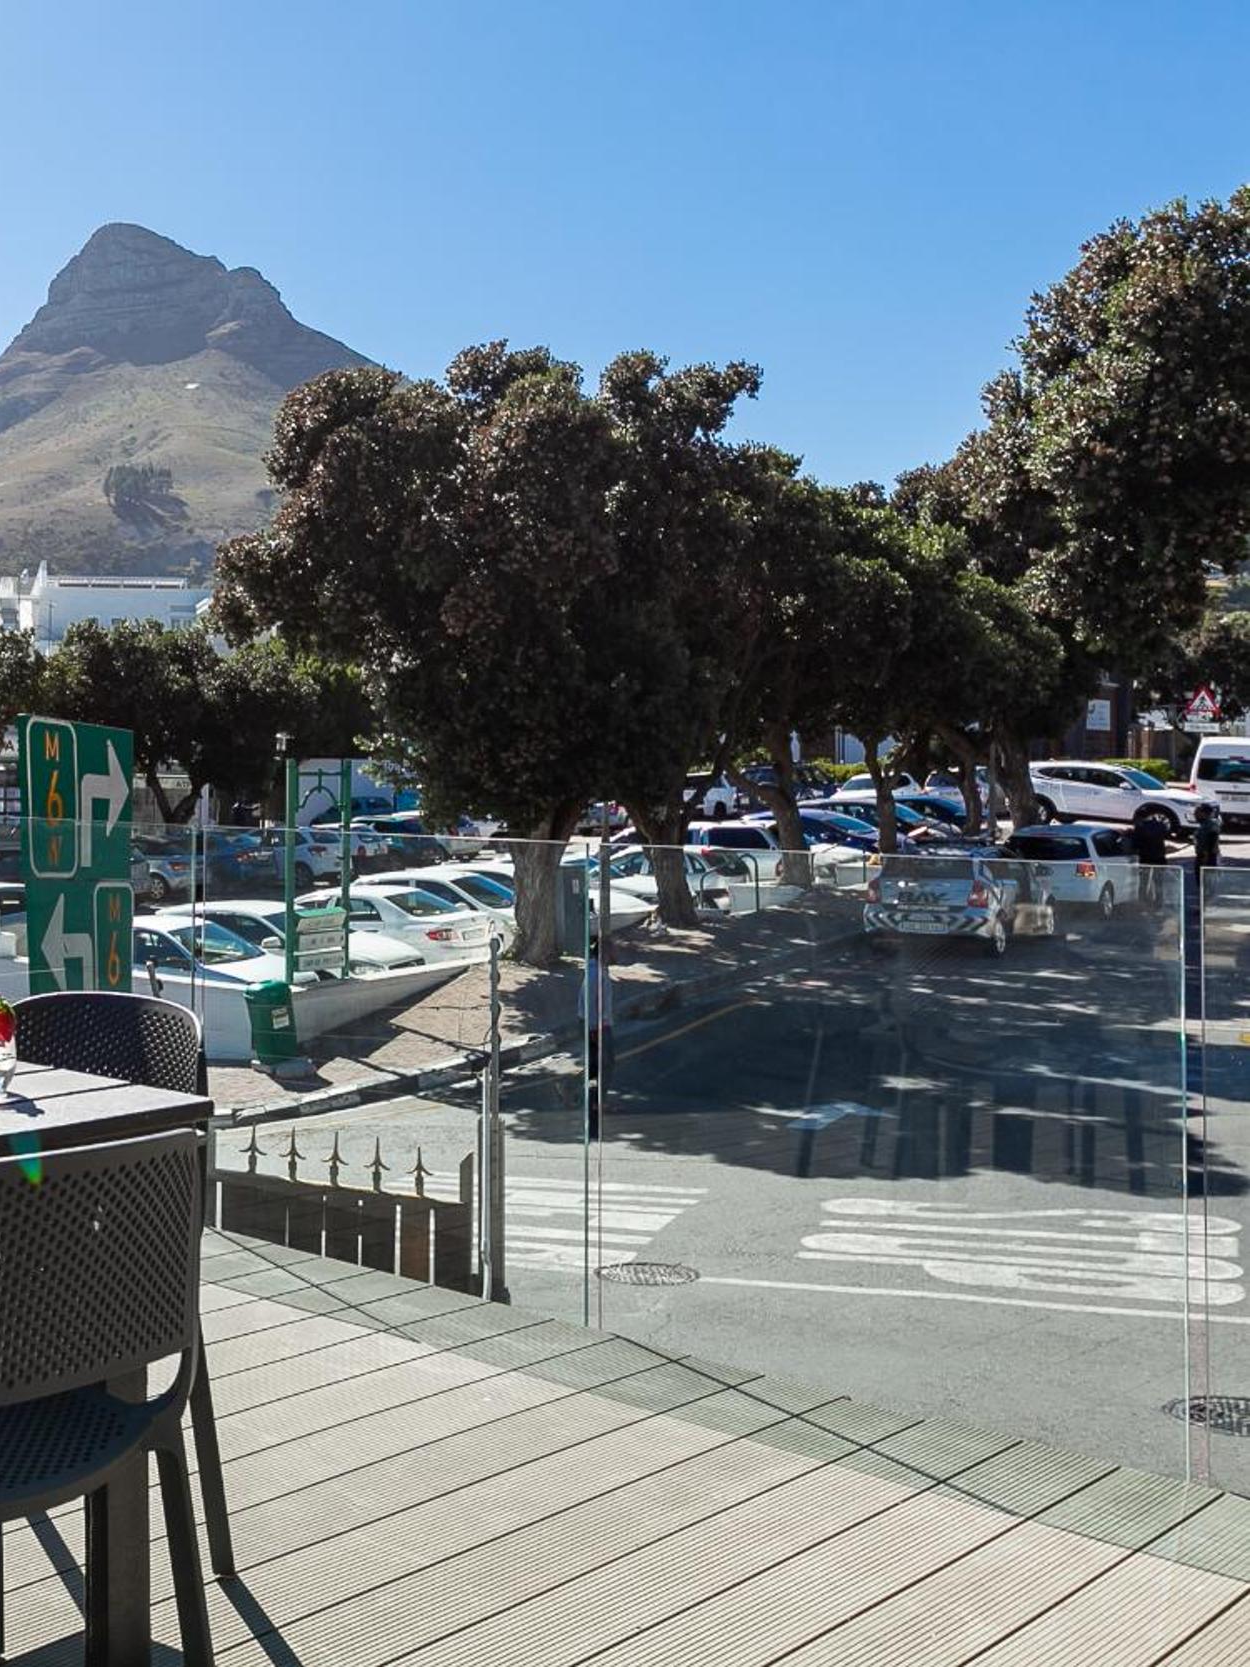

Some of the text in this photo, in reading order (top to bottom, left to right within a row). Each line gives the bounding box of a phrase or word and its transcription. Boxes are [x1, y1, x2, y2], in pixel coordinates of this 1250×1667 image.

[44, 729, 60, 761] M
[46, 768, 63, 828] 6
[109, 893, 121, 922] M
[108, 929, 120, 987] 6
[794, 1197, 1247, 1306] STOP
